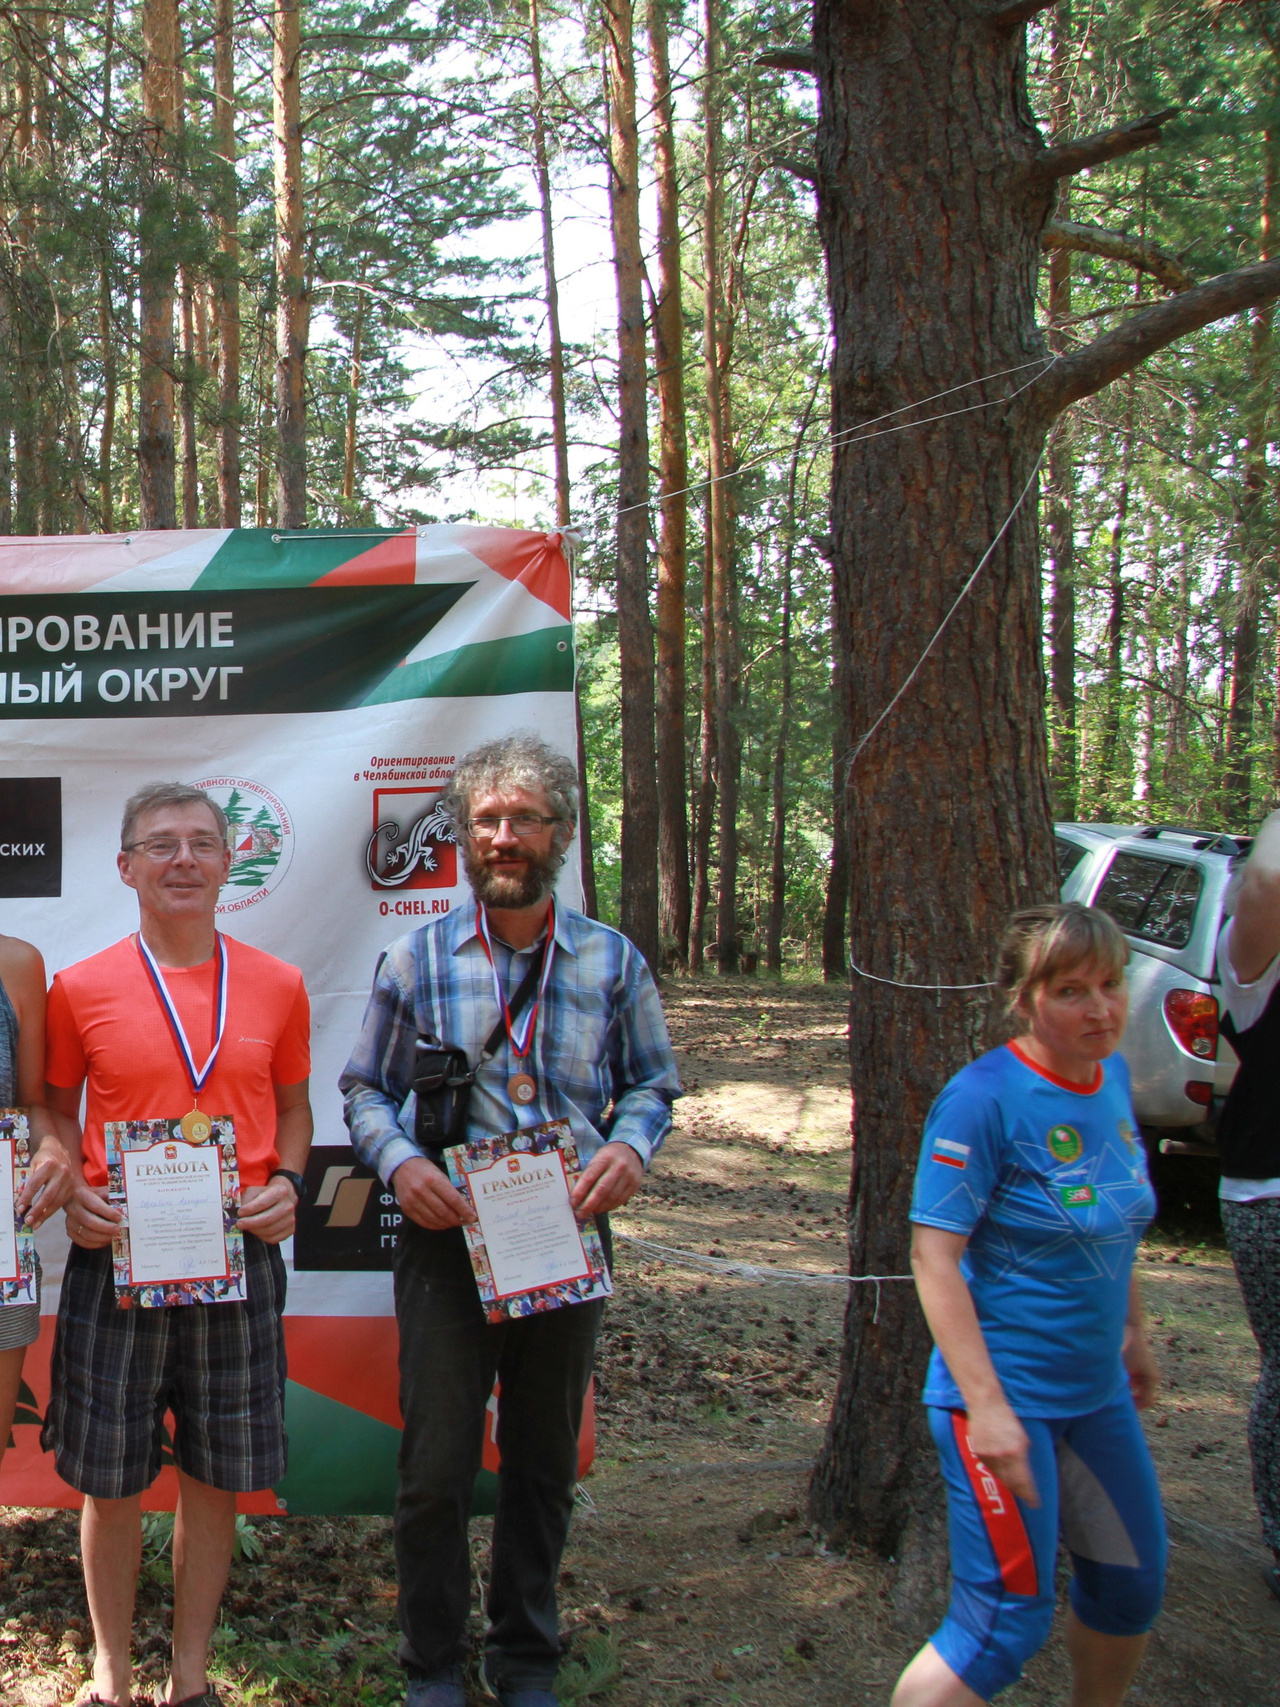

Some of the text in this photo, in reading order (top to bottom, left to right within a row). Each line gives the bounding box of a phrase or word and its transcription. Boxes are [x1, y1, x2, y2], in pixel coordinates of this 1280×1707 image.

[97, 667, 243, 703] ОКРУГ
[370, 755, 455, 769] Ориентирование
[353, 772, 360, 781] в
[363, 768, 427, 781] Челябинской
[237, 781, 291, 836] ОРИЕНТИРОВАНИЯ
[227, 887, 270, 912] ОБЛАСТИ
[379, 899, 450, 916] O-CHEL.RU
[136, 1161, 209, 1176] ГРАМОТА
[482, 1168, 554, 1194] ГРАМОТА
